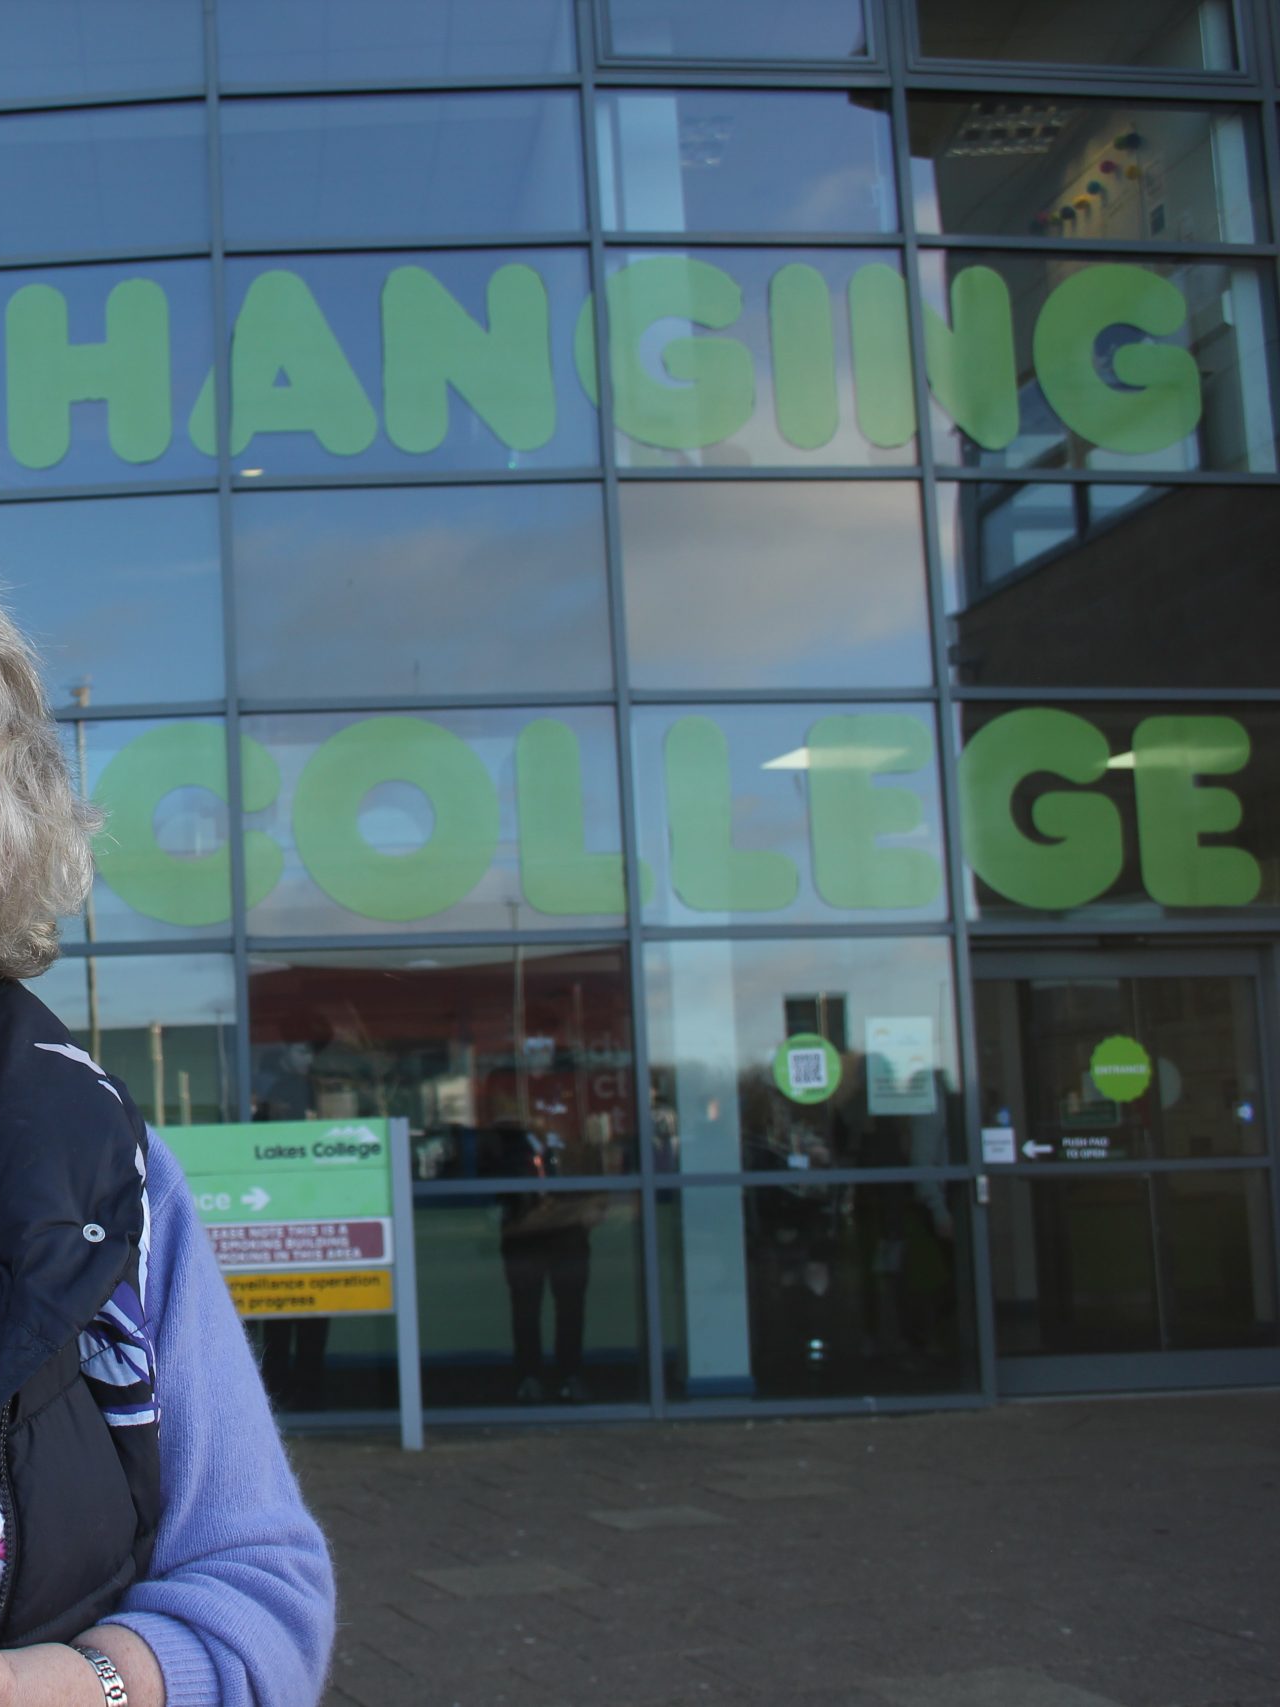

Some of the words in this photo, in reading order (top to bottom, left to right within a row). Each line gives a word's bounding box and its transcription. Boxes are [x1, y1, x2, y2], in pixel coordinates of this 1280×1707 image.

[89, 707, 1262, 928] COLLEGE
[1094, 1063, 1148, 1077] ENTRANCE
[1062, 1136, 1087, 1148] PUSH
[1088, 1136, 1110, 1147] PAD
[254, 1145, 307, 1160] Lakes
[312, 1141, 382, 1160] College
[1066, 1148, 1078, 1159] TO
[1079, 1148, 1107, 1159] OPEN
[248, 1226, 284, 1239] NOTE
[286, 1225, 319, 1238] THIS
[320, 1224, 335, 1236] IS
[337, 1224, 349, 1236] A
[220, 1238, 282, 1252] SMOKING
[285, 1236, 349, 1249] BUILDING
[216, 1251, 271, 1264] MOKING
[273, 1250, 290, 1261] IN
[291, 1249, 323, 1261] THIS
[325, 1247, 362, 1260] AREA
[309, 1274, 381, 1291] operation
[248, 1294, 316, 1311] progress
